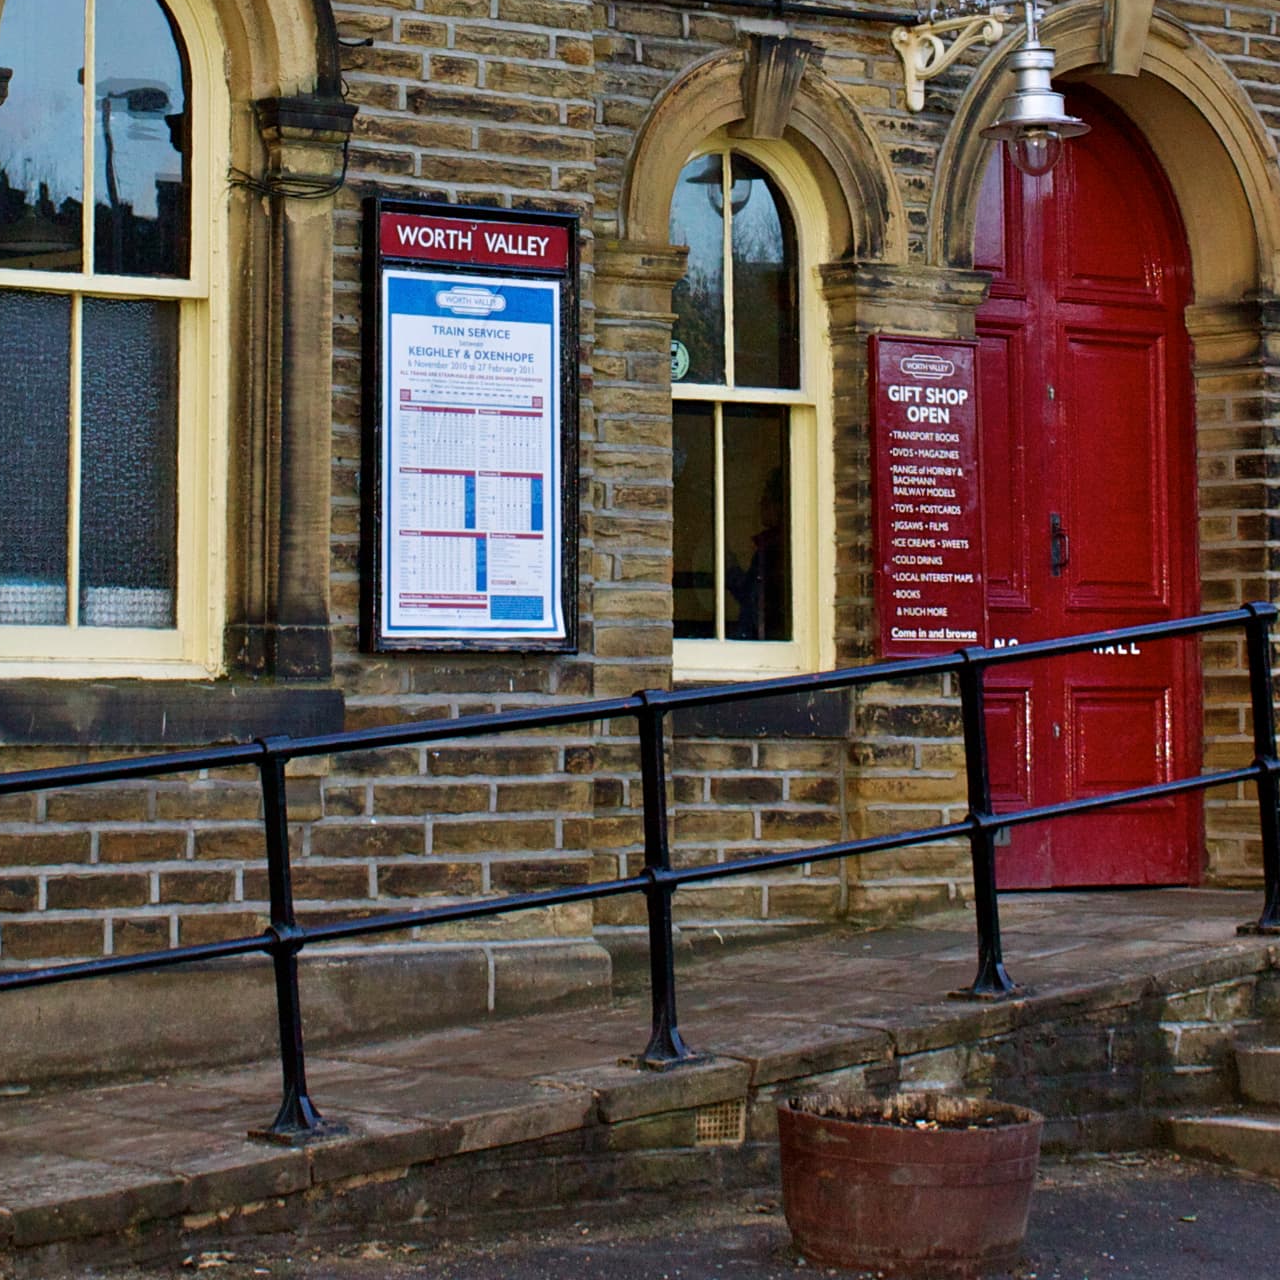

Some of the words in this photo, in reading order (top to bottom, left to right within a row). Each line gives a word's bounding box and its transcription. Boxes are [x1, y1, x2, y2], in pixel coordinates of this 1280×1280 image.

[396, 224, 472, 251] WORTH
[483, 232, 550, 257] VALLEY
[446, 296, 470, 305] WORTH
[432, 324, 465, 337] TRAIN
[468, 327, 511, 340] SERVICE
[408, 345, 460, 359] KEIGHLEY
[463, 350, 471, 359] &
[474, 350, 535, 363] OXENHOPE
[414, 359, 448, 369] November
[906, 362, 928, 371] WORTH
[928, 363, 949, 372] VALLEY
[888, 385, 923, 403] GIFT
[925, 387, 969, 406] SHOP
[907, 406, 950, 425] OPEN
[893, 430, 934, 441] TRANSPORT
[934, 432, 960, 443] BOOKS
[918, 449, 960, 460] MAGAZINES
[893, 465, 918, 475] RANGE
[918, 465, 927, 475] of
[926, 466, 956, 476] HORNBY
[956, 467, 963, 477] &
[893, 476, 936, 486] BACHMANN
[893, 486, 927, 497] RAILWAY
[927, 487, 956, 498] MODELS
[894, 504, 914, 514] TOYS
[919, 504, 962, 515] POSTCARDS
[894, 520, 923, 532] JIGSAWS
[929, 522, 949, 532] FILMS
[894, 537, 907, 548] ICE
[907, 538, 936, 549] CREAMS
[941, 539, 969, 550] SWEETS
[895, 555, 916, 565] COLD
[916, 555, 943, 566] DRINKS
[895, 572, 920, 582] LOCAL
[919, 573, 953, 583] INTEREST
[953, 574, 974, 584] MAPS
[895, 589, 921, 599] BOOKS
[896, 607, 903, 616] &
[903, 607, 927, 617] MUCH
[926, 607, 948, 617] MORE
[891, 627, 917, 639] Come
[918, 628, 927, 639] in
[928, 628, 945, 639] and
[945, 629, 978, 640] browse
